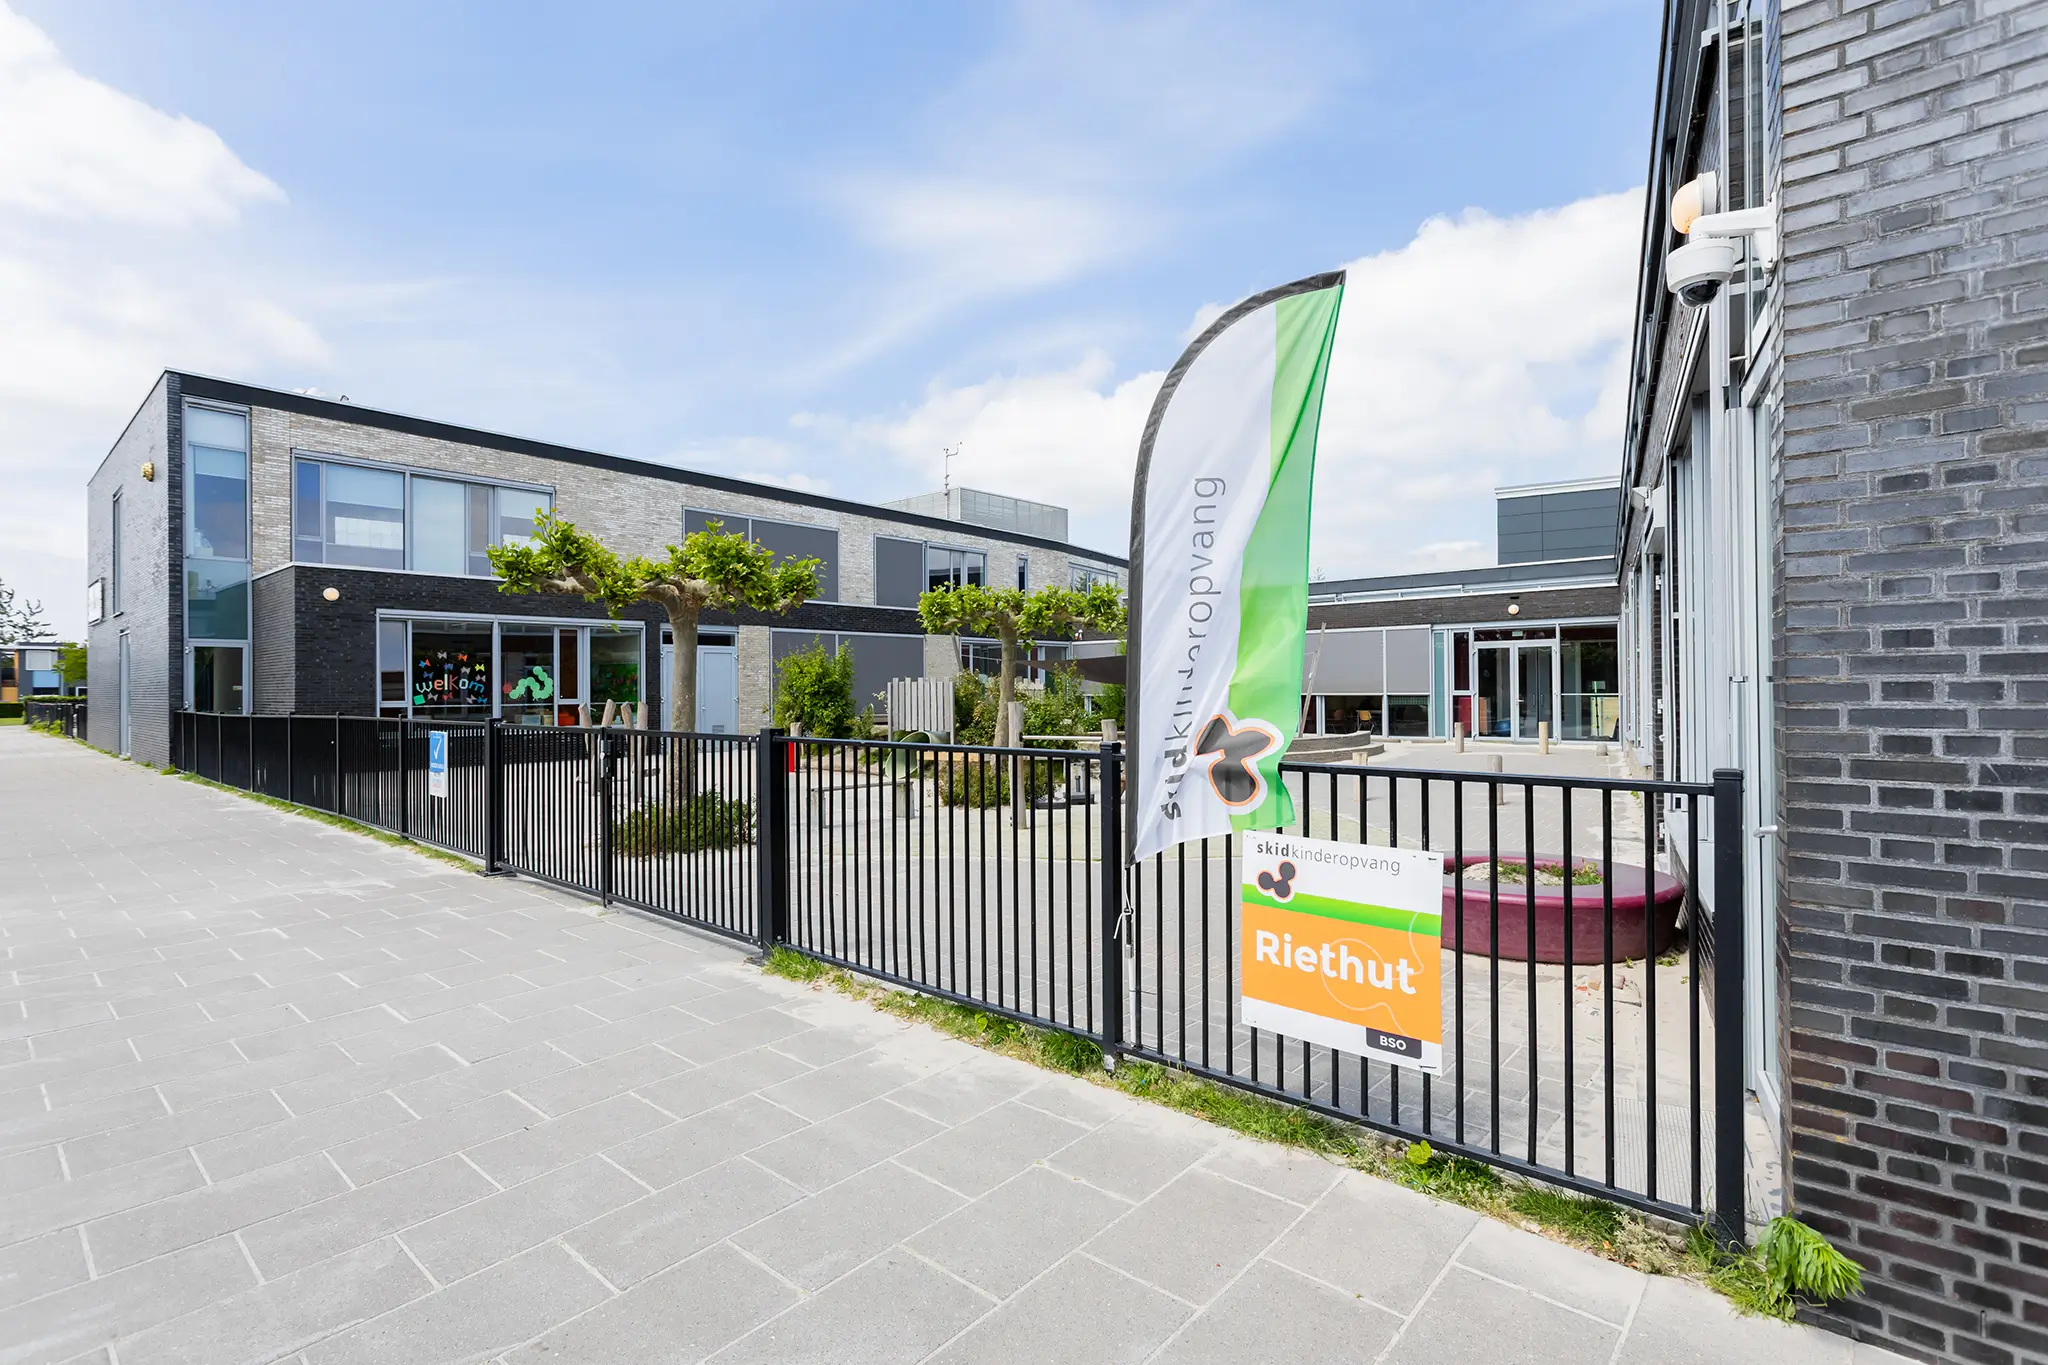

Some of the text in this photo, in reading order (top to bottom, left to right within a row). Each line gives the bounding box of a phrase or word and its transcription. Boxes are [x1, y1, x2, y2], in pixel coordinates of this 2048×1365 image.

[1257, 841, 1400, 876] skidkinderopvang
[1256, 930, 1416, 994] Riethut
[1379, 1035, 1407, 1051] BSO
